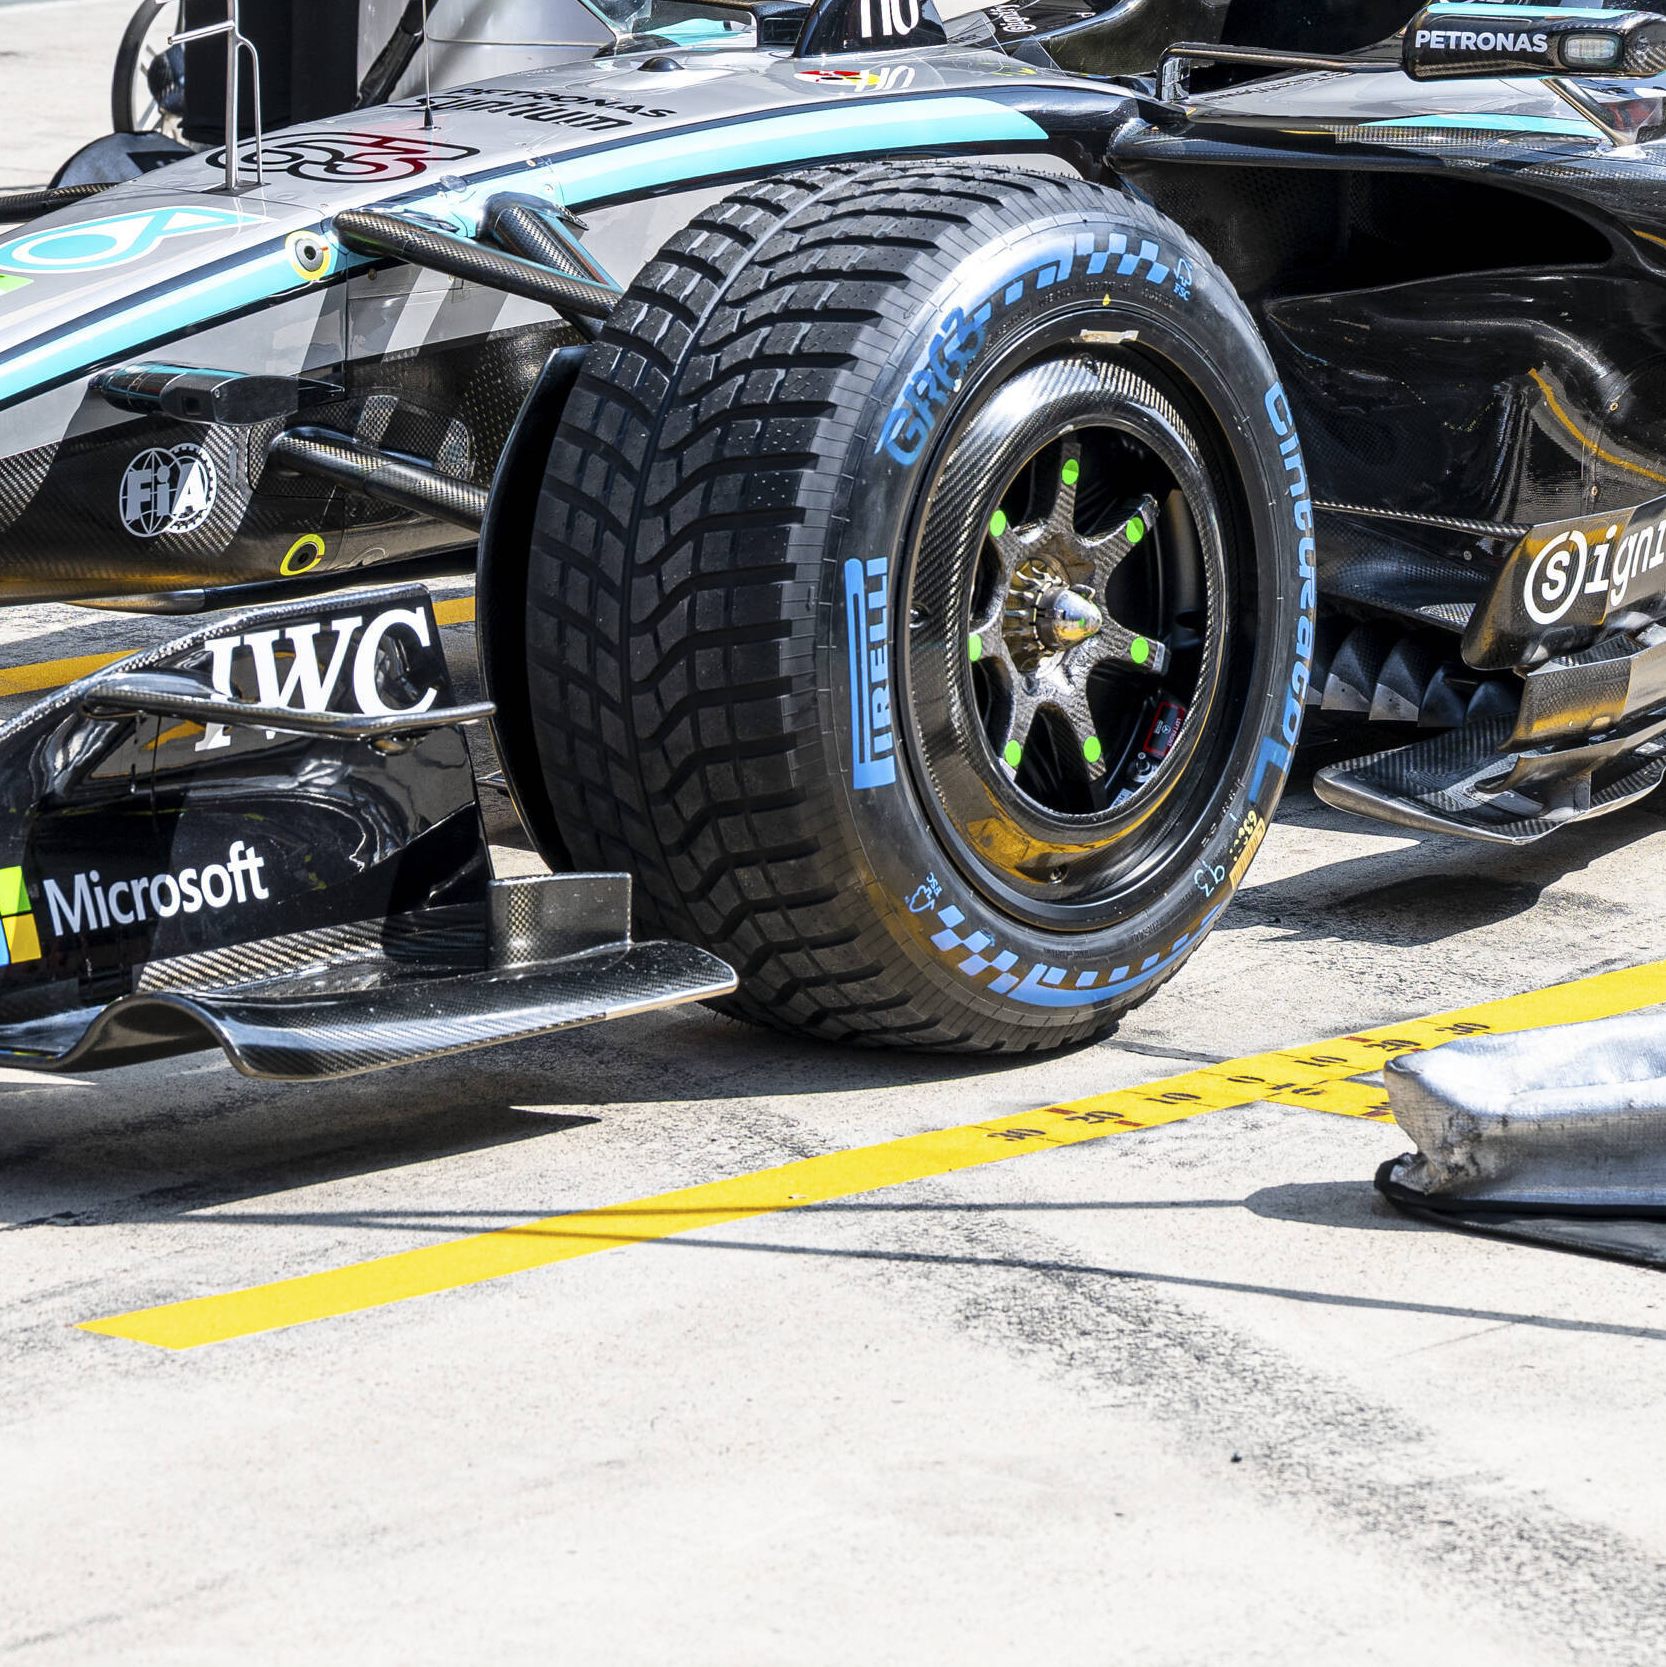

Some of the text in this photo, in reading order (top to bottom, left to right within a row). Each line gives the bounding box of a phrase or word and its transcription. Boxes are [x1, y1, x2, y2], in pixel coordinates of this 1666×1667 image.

[1414, 30, 1548, 54] PETRONAS
[443, 86, 677, 120] PETRONAS
[1264, 381, 1317, 746] Cinturato
[194, 606, 438, 753] IWC
[844, 556, 897, 790] PIRELLI
[43, 840, 269, 937] Microsoft
[1293, 1055, 1350, 1068] 10
[1226, 1075, 1266, 1085] 0
[1144, 1092, 1202, 1105] 10
